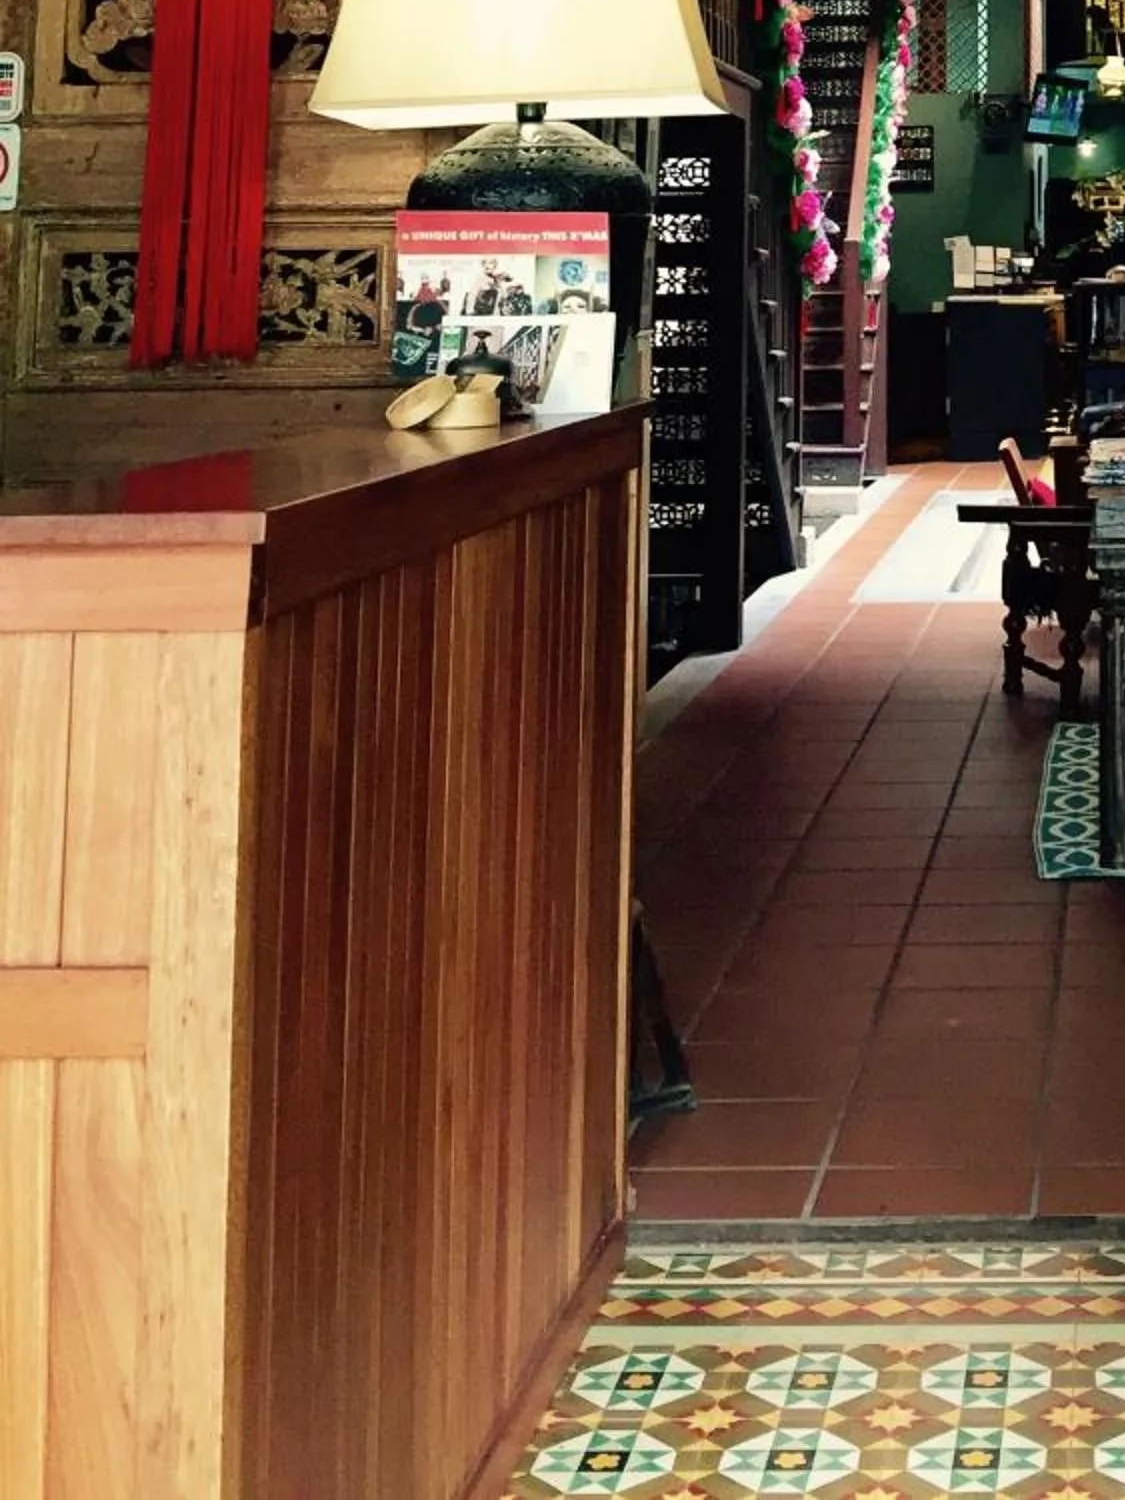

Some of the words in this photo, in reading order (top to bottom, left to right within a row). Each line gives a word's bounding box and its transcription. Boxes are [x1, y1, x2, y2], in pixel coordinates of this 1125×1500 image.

[411, 231, 457, 241] UNIQUE
[459, 230, 484, 241] GIFT
[487, 231, 498, 241] of
[500, 230, 540, 243] history
[541, 231, 568, 241] THIS
